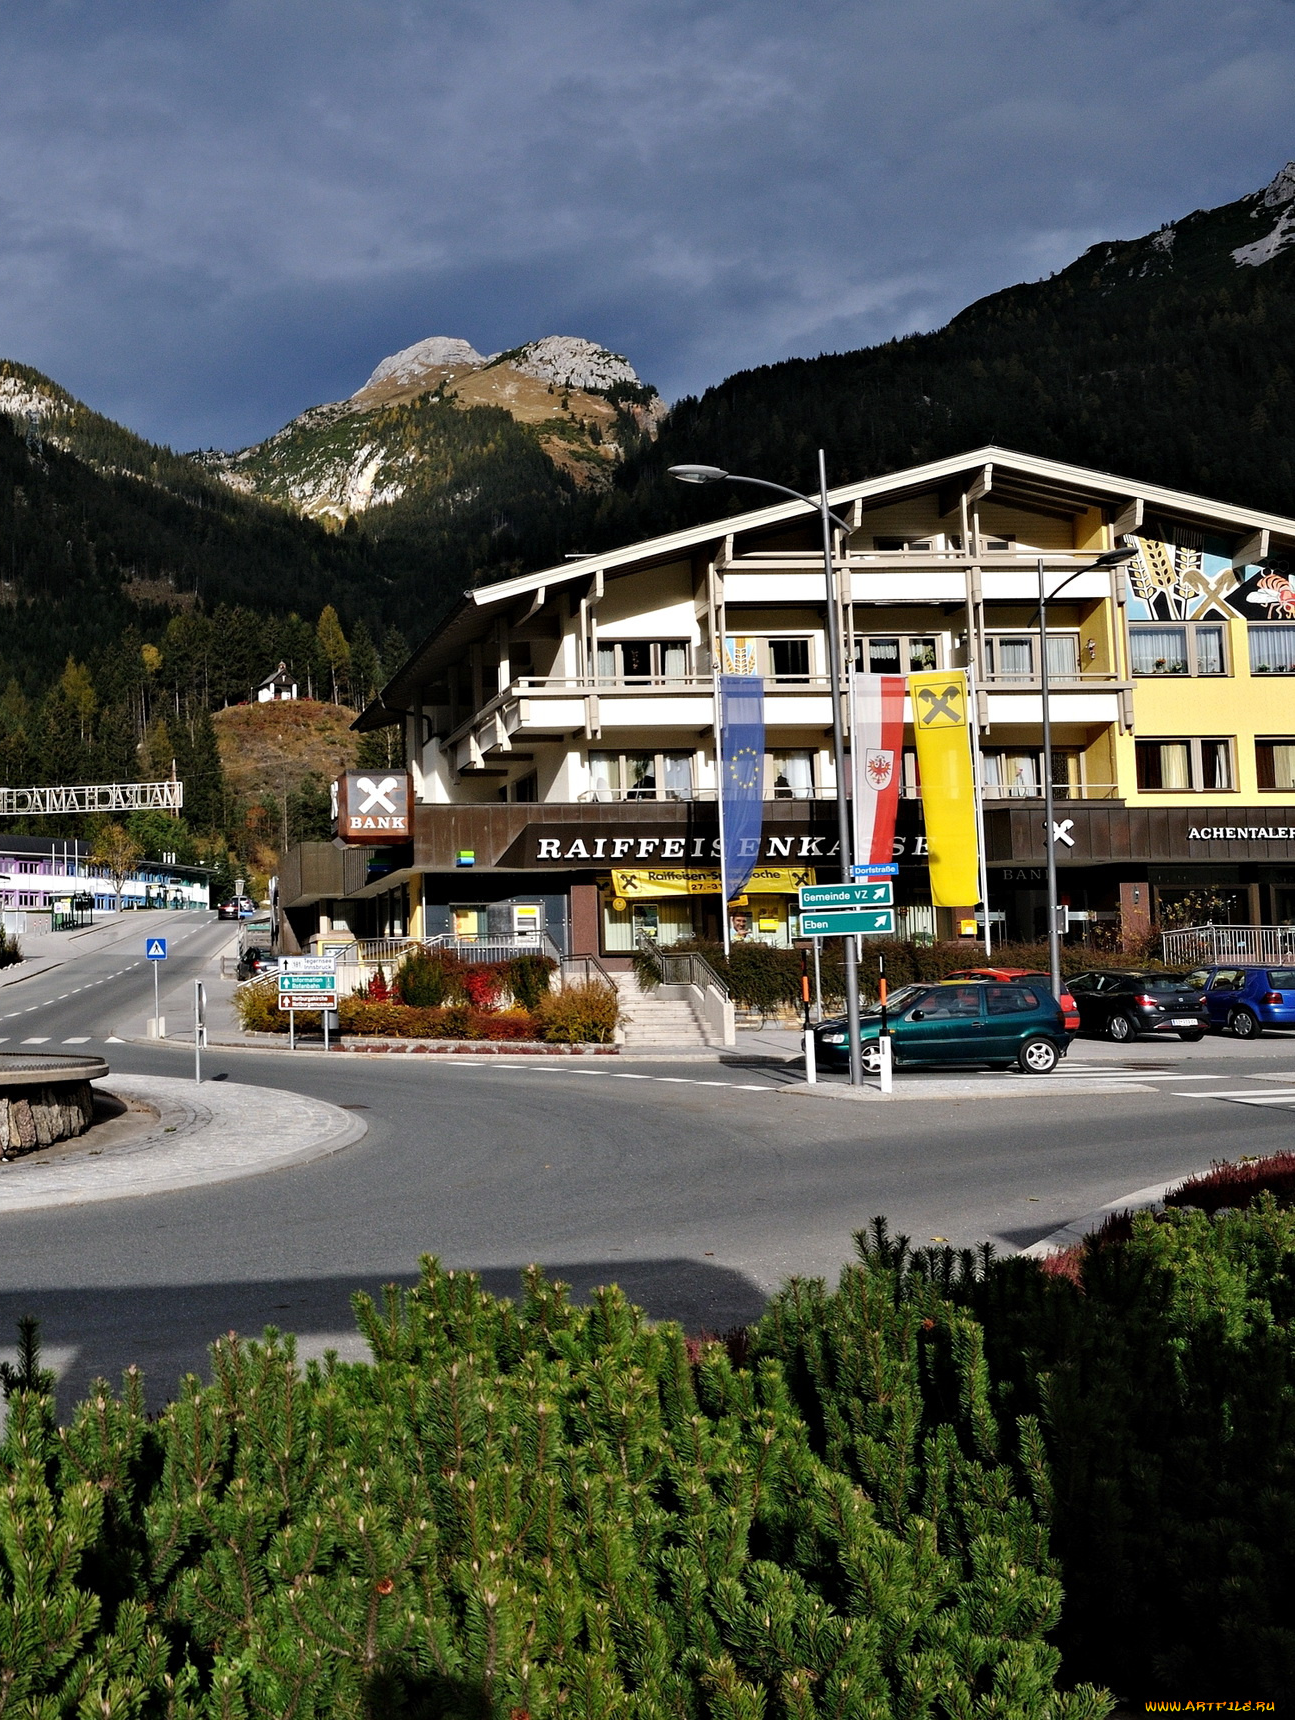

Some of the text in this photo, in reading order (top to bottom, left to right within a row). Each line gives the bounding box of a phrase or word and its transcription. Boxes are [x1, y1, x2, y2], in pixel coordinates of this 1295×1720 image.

[350, 816, 405, 829] BANK
[648, 870, 781, 882] Raiffeisen-Soche
[855, 865, 896, 875] Dorfstraße
[803, 890, 868, 902] Gemeinde VZ
[804, 920, 829, 929] Eben
